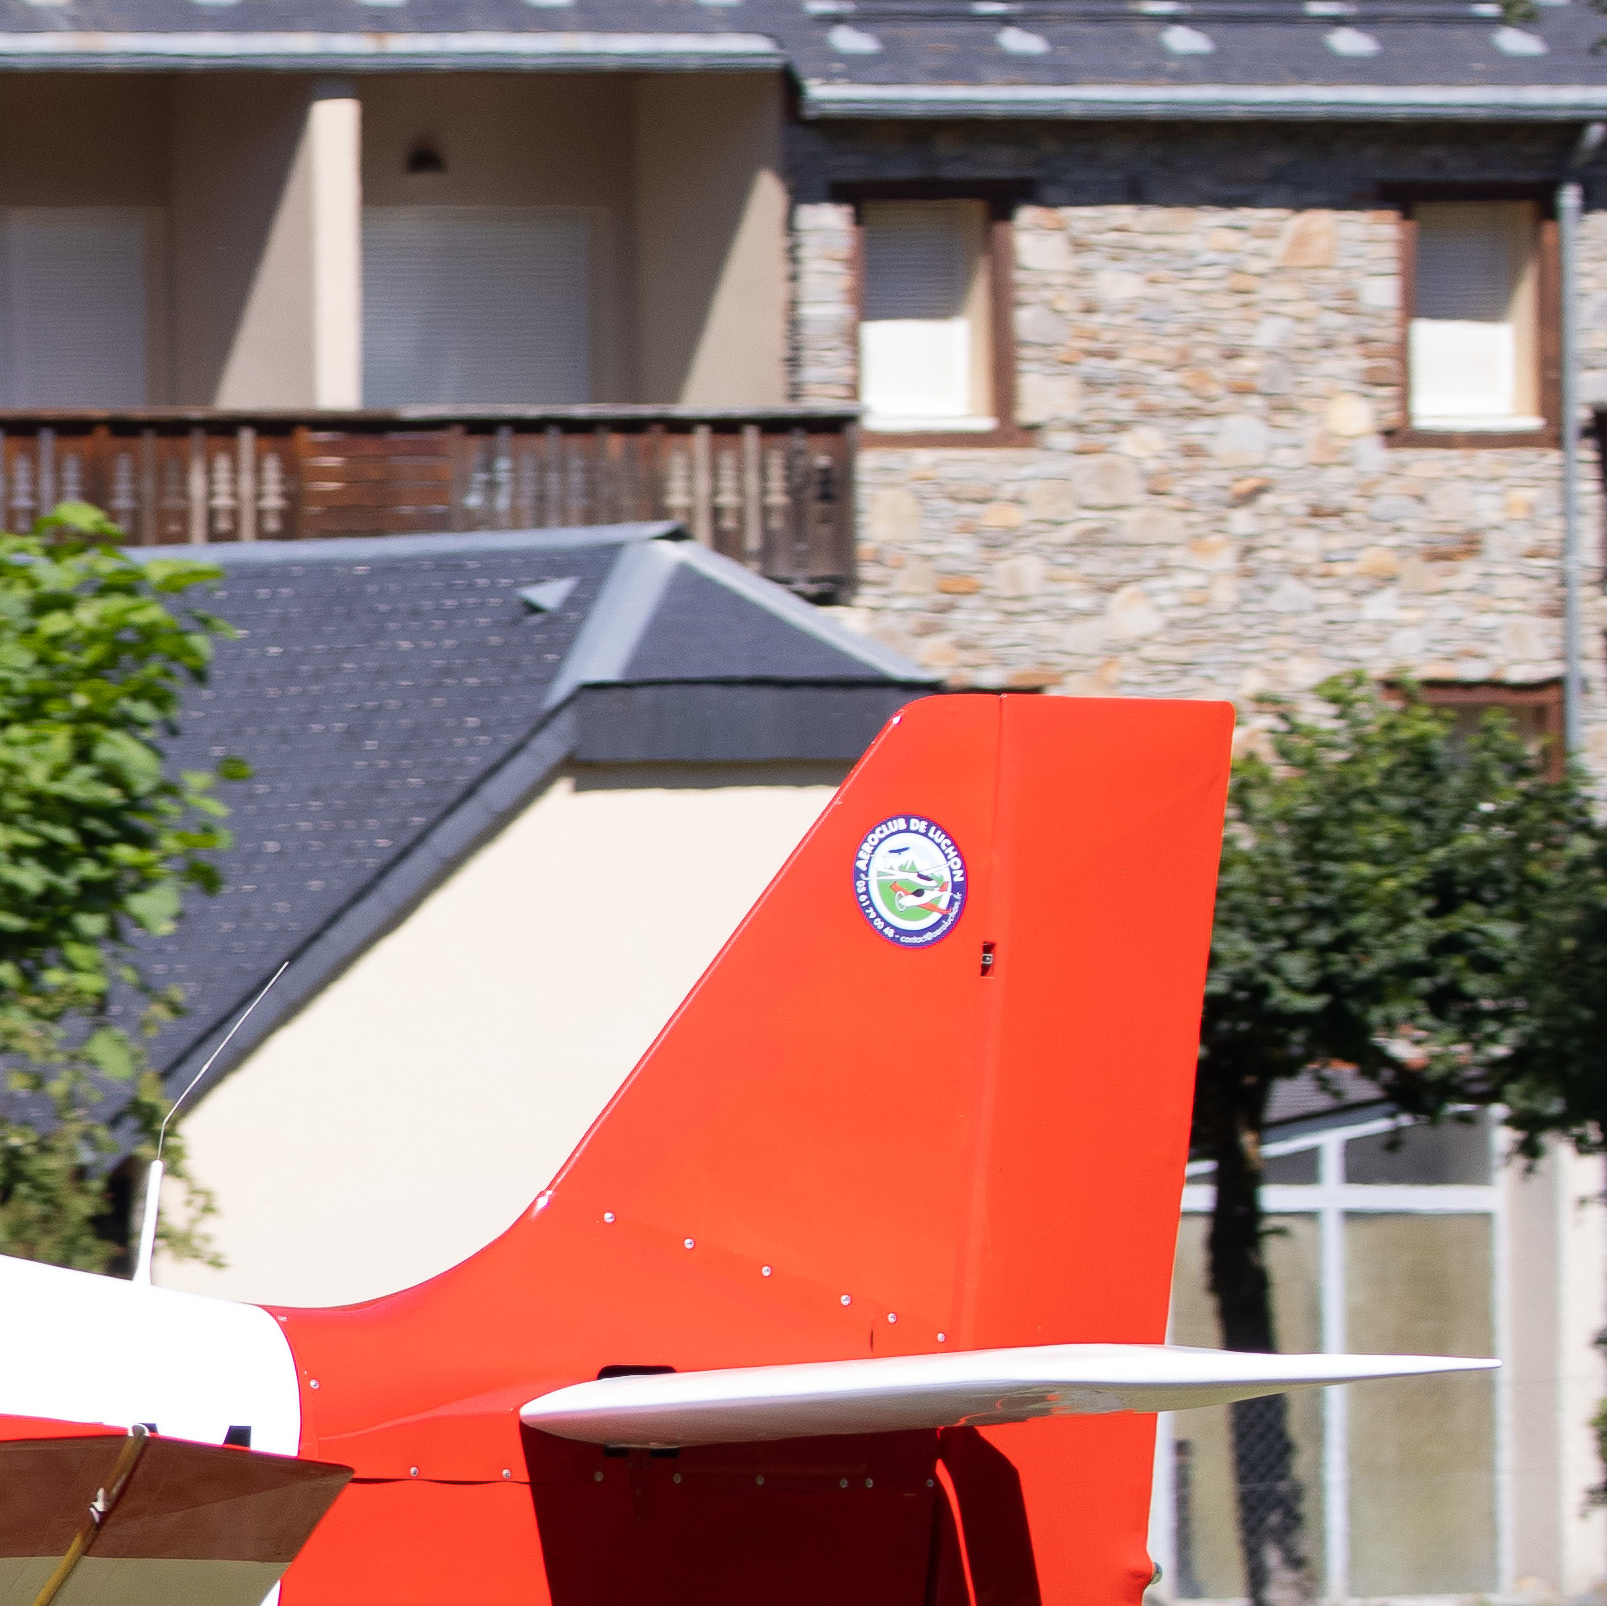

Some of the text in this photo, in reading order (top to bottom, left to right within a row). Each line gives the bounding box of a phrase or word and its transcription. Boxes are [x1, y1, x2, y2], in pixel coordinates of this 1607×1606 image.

[854, 817, 964, 882] AEROCLUB DE LUCHON
[858, 894, 870, 907] 61
